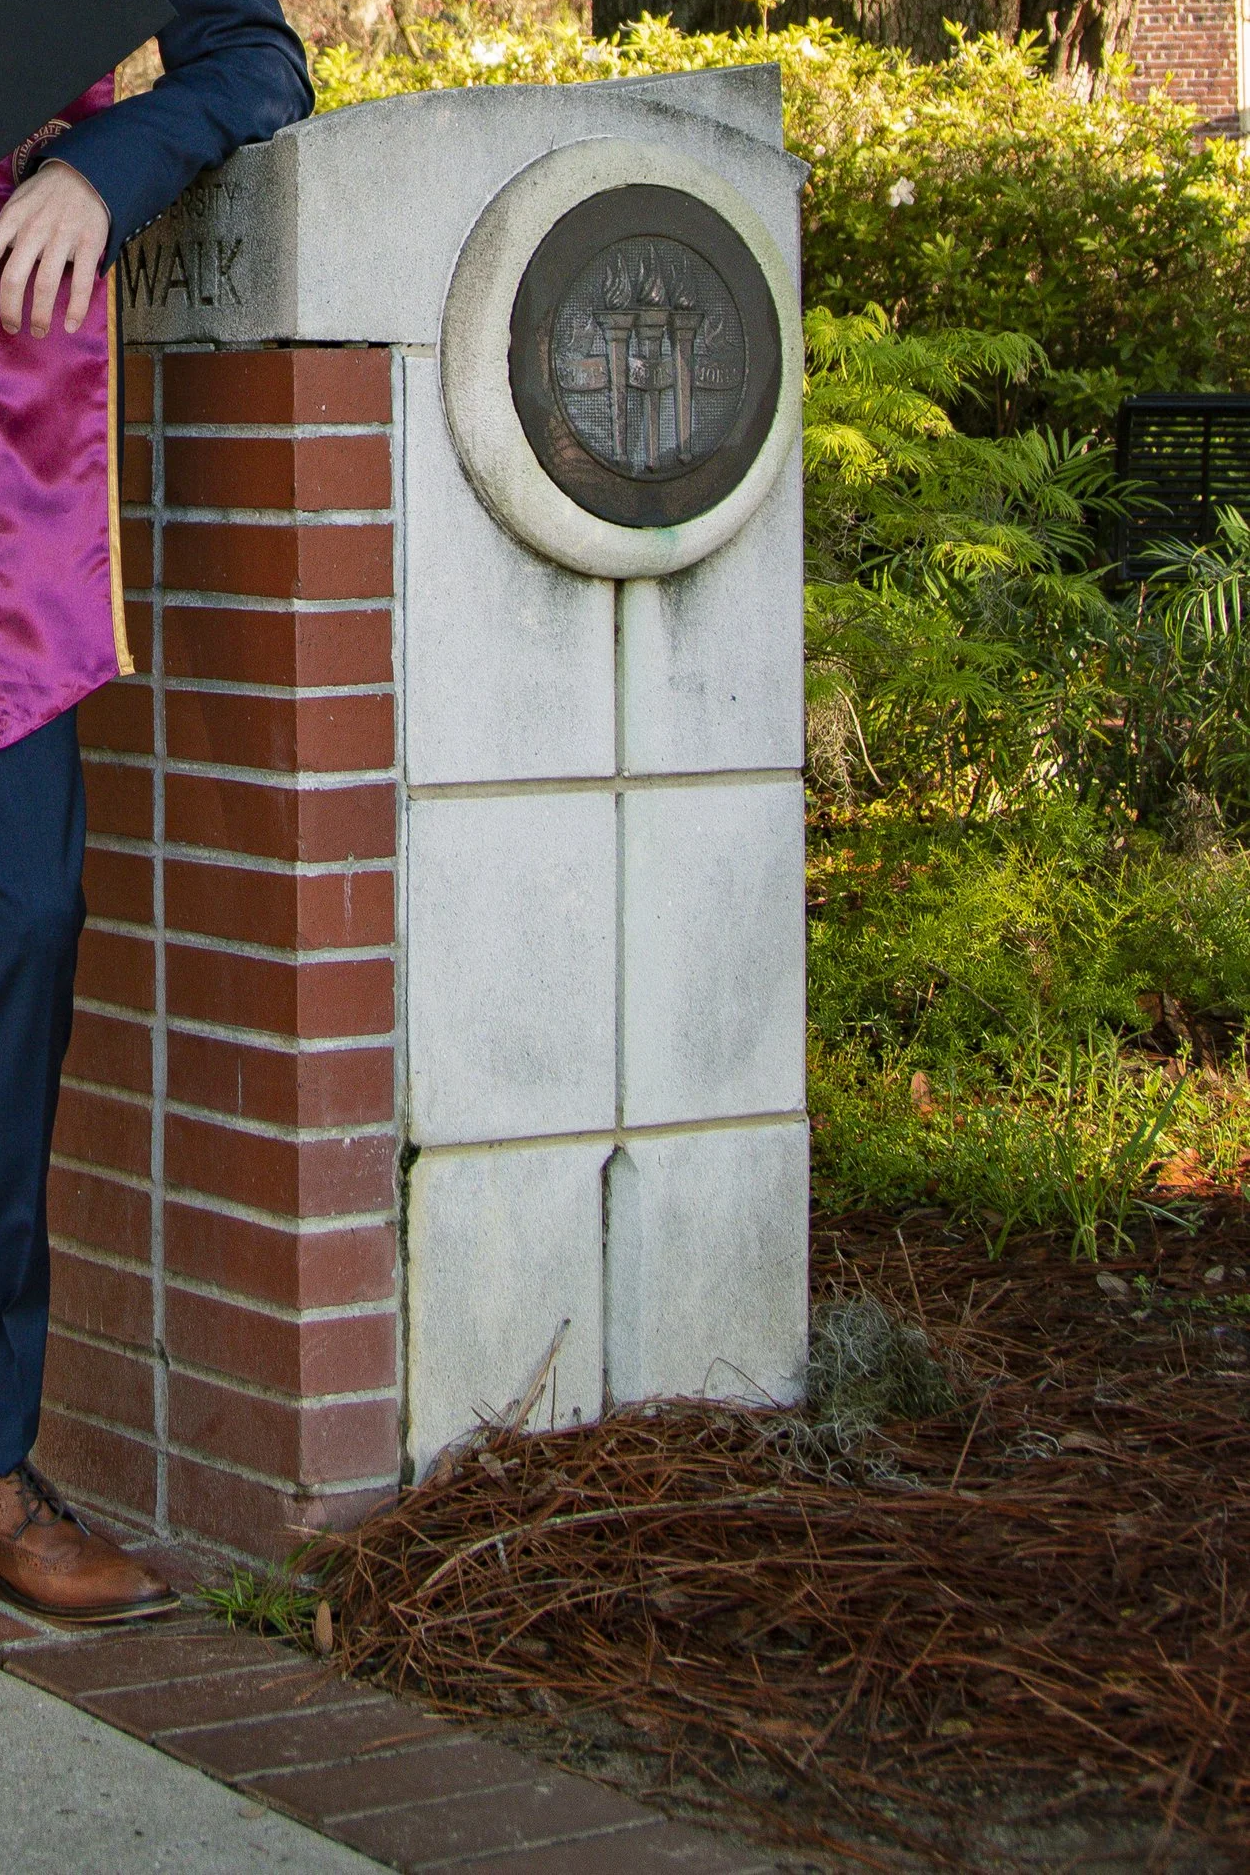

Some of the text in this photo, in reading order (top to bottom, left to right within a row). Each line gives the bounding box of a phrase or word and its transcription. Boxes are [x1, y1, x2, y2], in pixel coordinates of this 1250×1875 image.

[18, 124, 62, 174] ORIDA STATE
[168, 183, 239, 219] ERSITY
[121, 239, 243, 308] WALK
